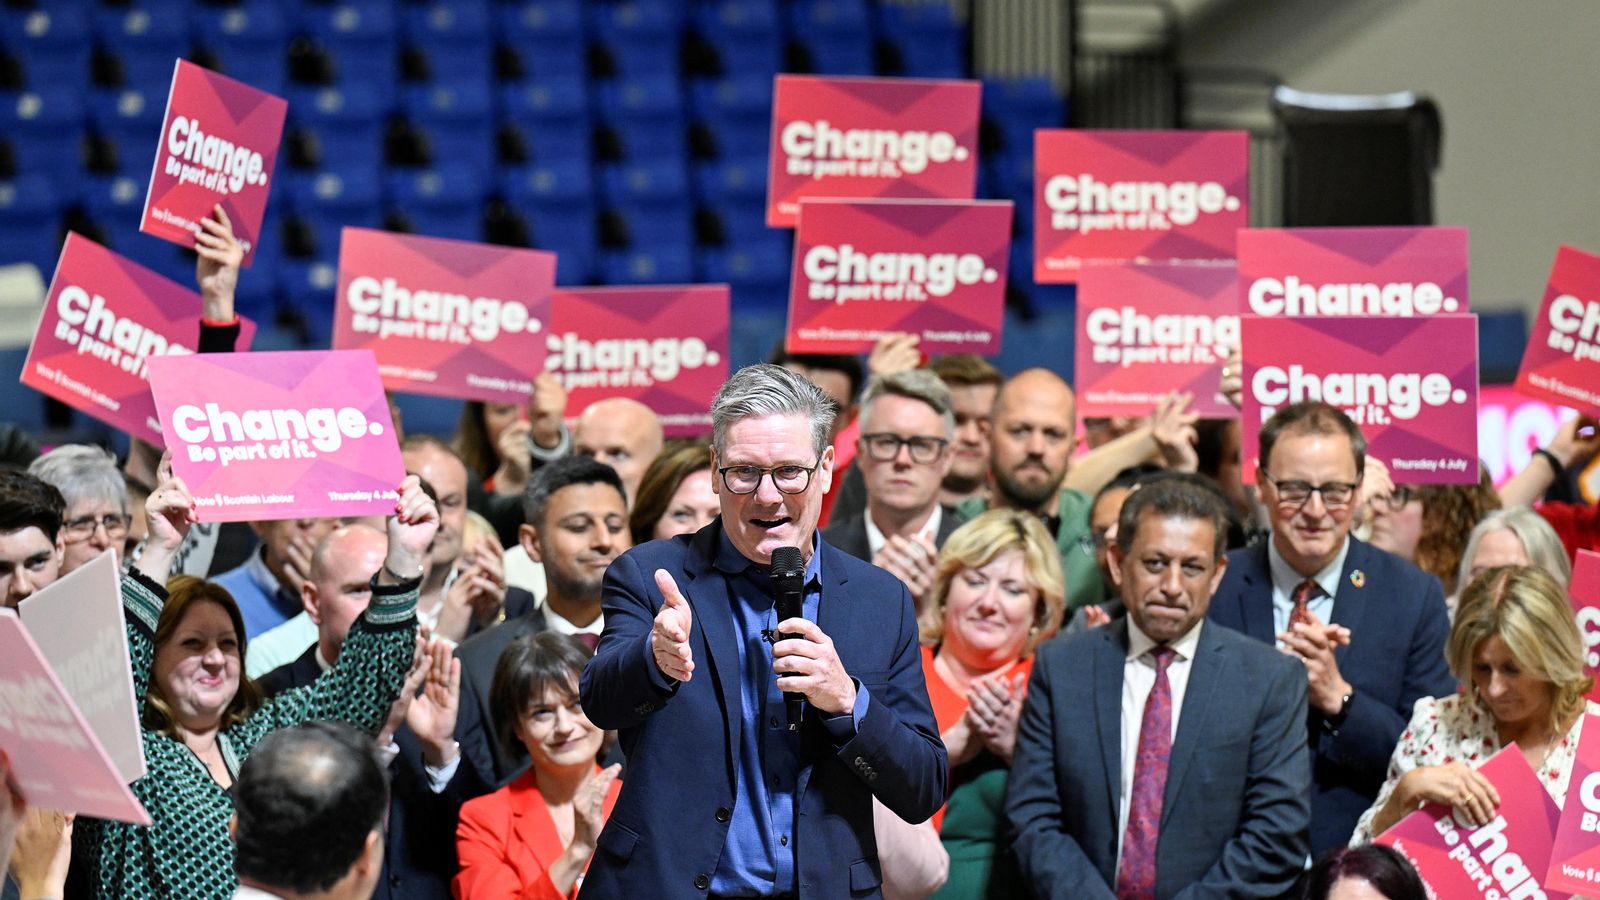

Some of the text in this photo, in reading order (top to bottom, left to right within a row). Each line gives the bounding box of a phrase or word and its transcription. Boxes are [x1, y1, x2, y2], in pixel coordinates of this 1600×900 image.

[167, 115, 267, 193] Change.
[781, 120, 969, 174] Change.
[178, 164, 206, 184] part
[205, 170, 218, 190] of
[813, 159, 858, 180] part
[858, 160, 879, 177] of
[1044, 173, 1240, 225] Change.
[1079, 212, 1125, 234] part
[804, 244, 998, 296] Change.
[808, 282, 836, 300] Be
[836, 282, 882, 305] part
[882, 282, 904, 301] of
[1248, 276, 1459, 316] Change.
[347, 276, 542, 342] Change.
[379, 318, 426, 340] part
[426, 323, 449, 342] of
[1547, 329, 1575, 353] Be
[54, 319, 81, 345] Be
[77, 334, 121, 367] part
[120, 353, 144, 376] of
[1121, 345, 1168, 368] part
[1169, 345, 1192, 363] of
[564, 372, 610, 393] part
[609, 371, 632, 388] of
[1251, 364, 1468, 420] Change.
[1366, 404, 1391, 425] it.
[172, 402, 384, 453] Change.
[187, 438, 317, 467] Be part of it.
[1392, 458, 1468, 472] Thursday 4 July
[193, 493, 295, 506] Vote Scottish Labour
[327, 490, 373, 503] Thursday
[373, 490, 381, 500] 4
[1434, 815, 1461, 846] Be
[1448, 843, 1493, 892] part
[1562, 864, 1586, 879] Vote
